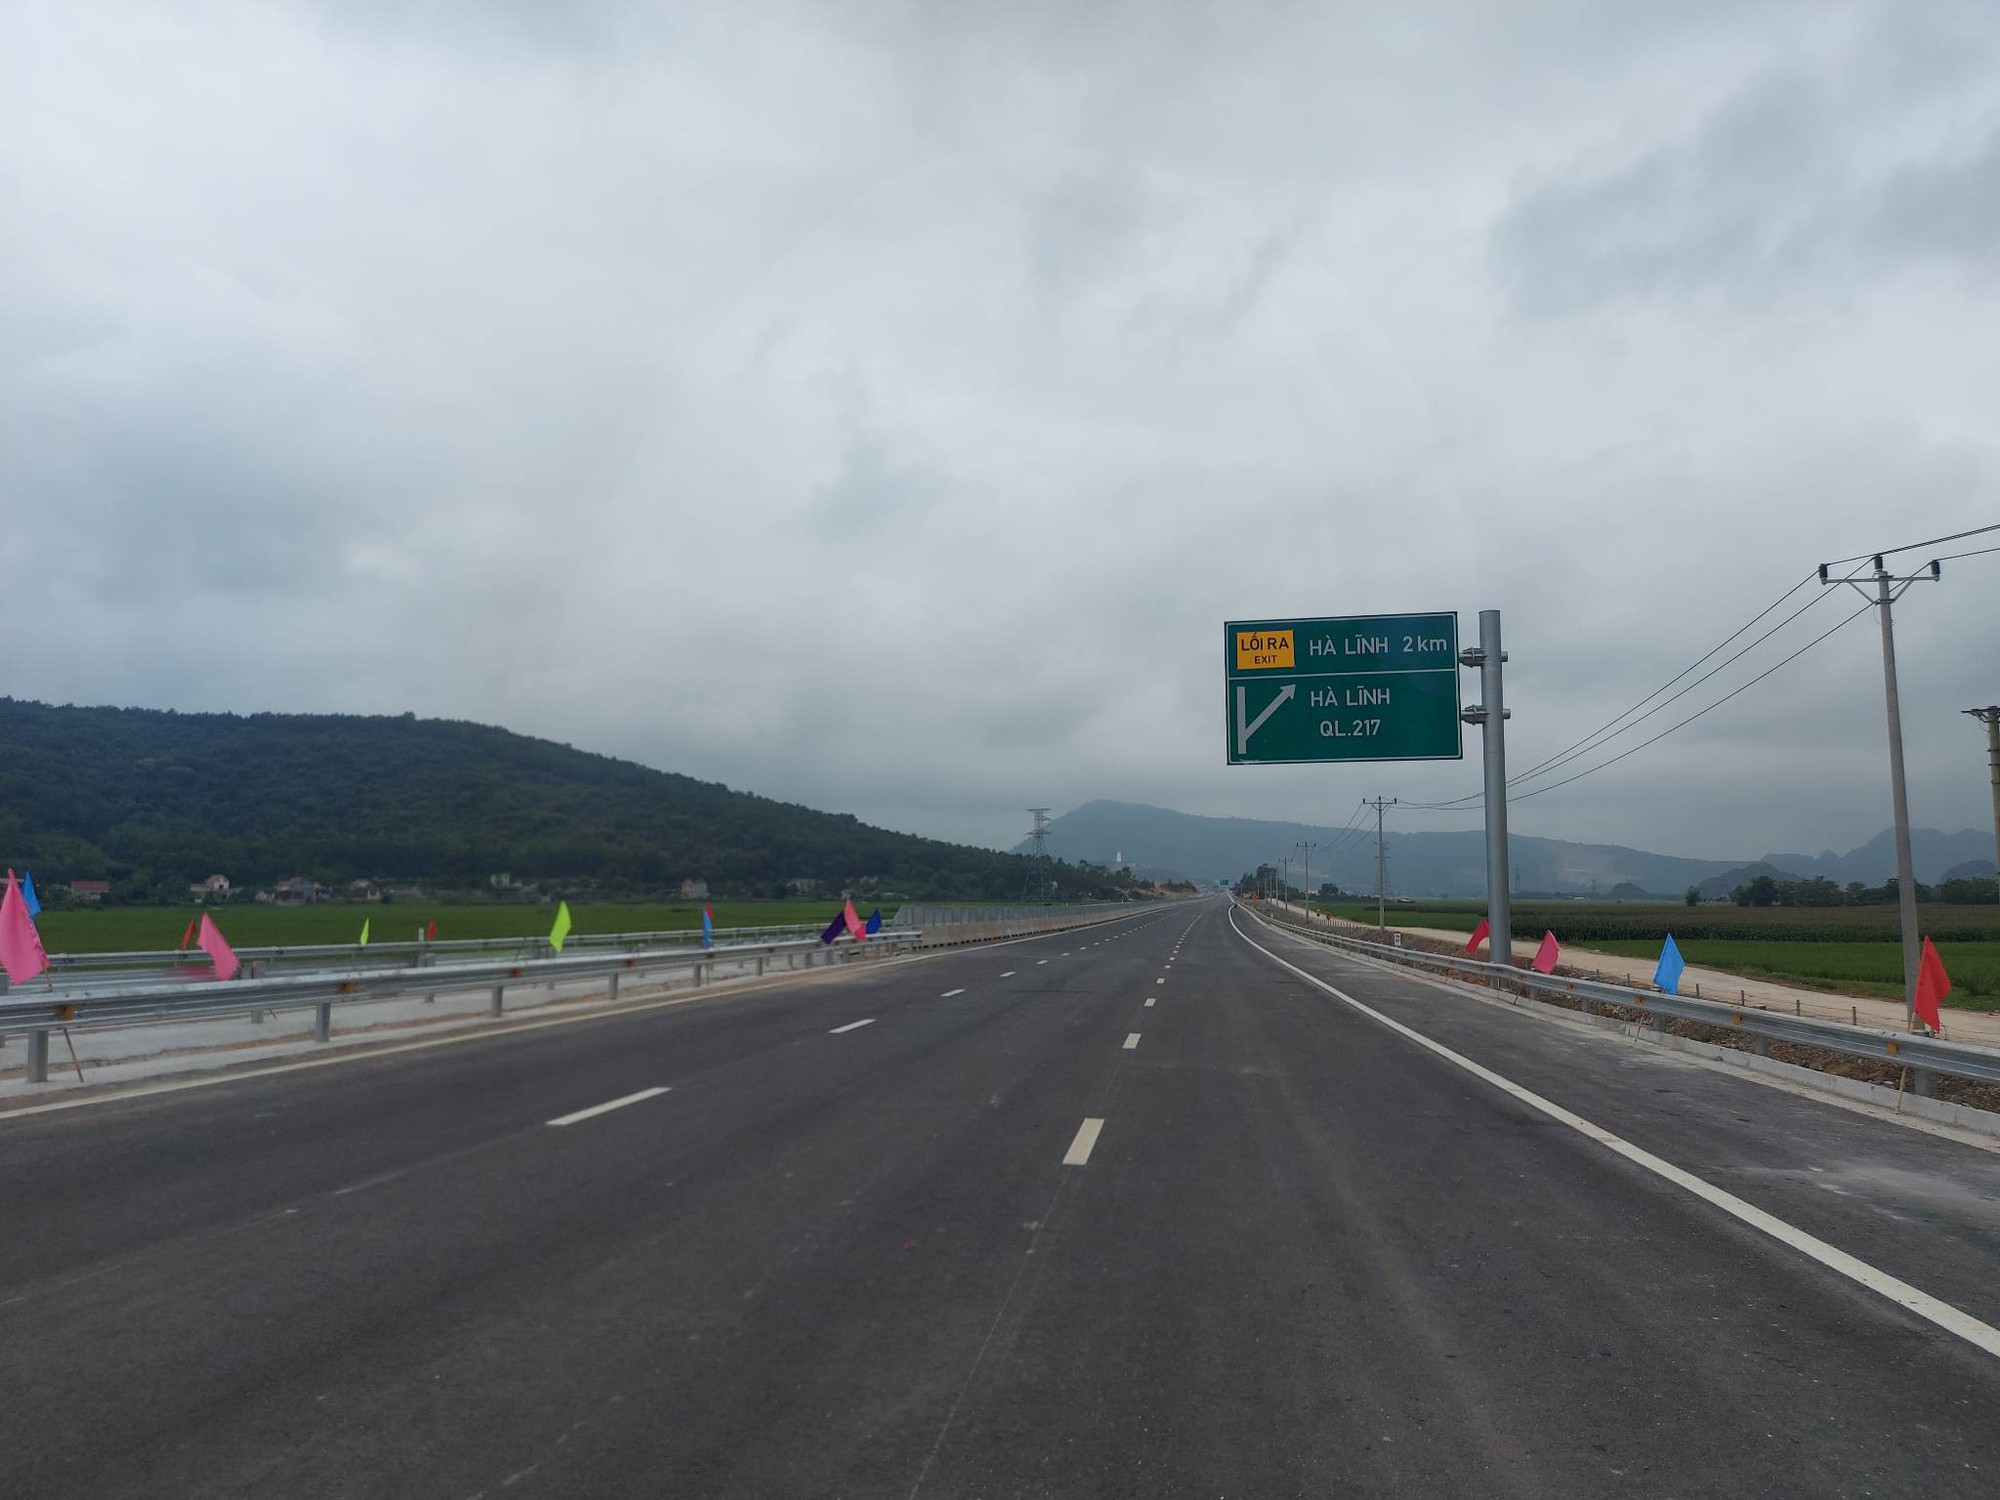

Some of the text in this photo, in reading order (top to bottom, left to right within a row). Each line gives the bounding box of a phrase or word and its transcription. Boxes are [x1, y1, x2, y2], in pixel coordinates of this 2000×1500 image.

[1241, 632, 1289, 651] LỐI RA
[1309, 634, 1337, 656] HÀ
[1344, 634, 1389, 655] LĨNH
[1254, 655, 1278, 664] EXIT
[1310, 685, 1391, 707] HÀ LĨNH
[1319, 719, 1381, 737] QL.217
